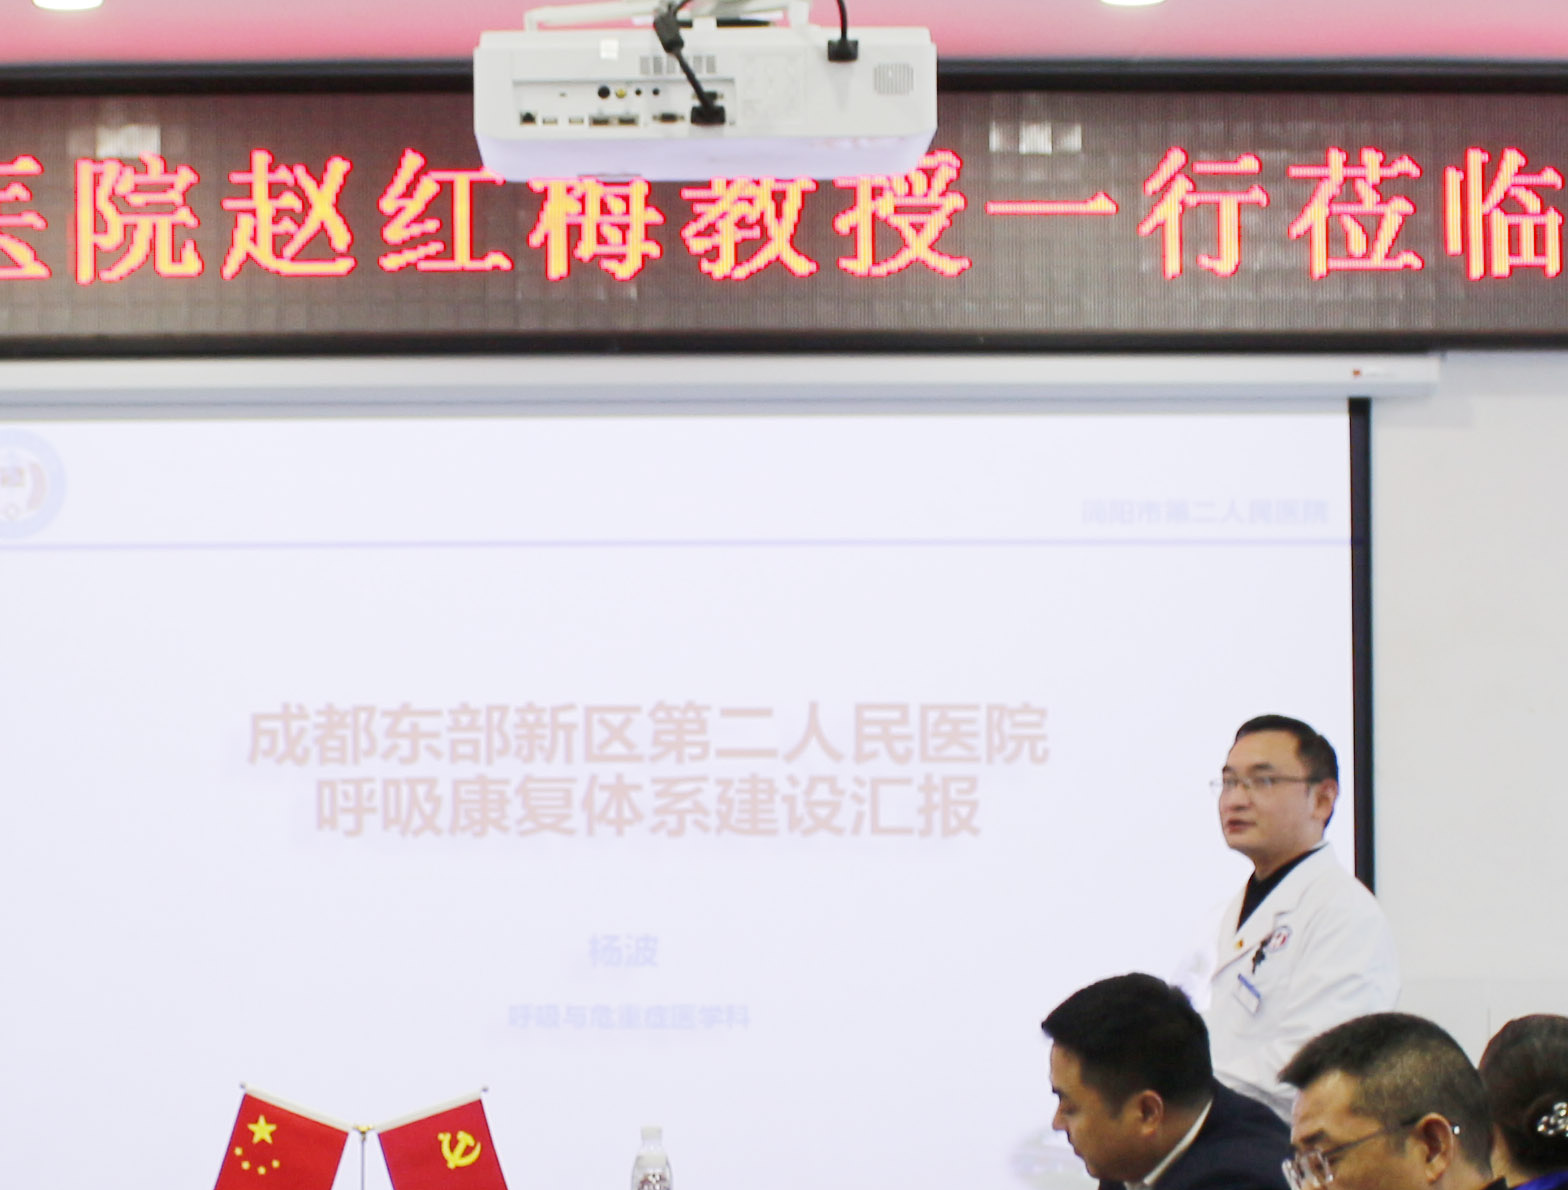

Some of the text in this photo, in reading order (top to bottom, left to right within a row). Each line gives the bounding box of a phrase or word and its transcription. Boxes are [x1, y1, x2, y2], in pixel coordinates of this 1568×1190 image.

[246, 702, 1050, 766] 成都东部新区第二人民医院
[314, 774, 982, 840] 呼吸康复体系建设汇报
[587, 932, 660, 968] 杨波
